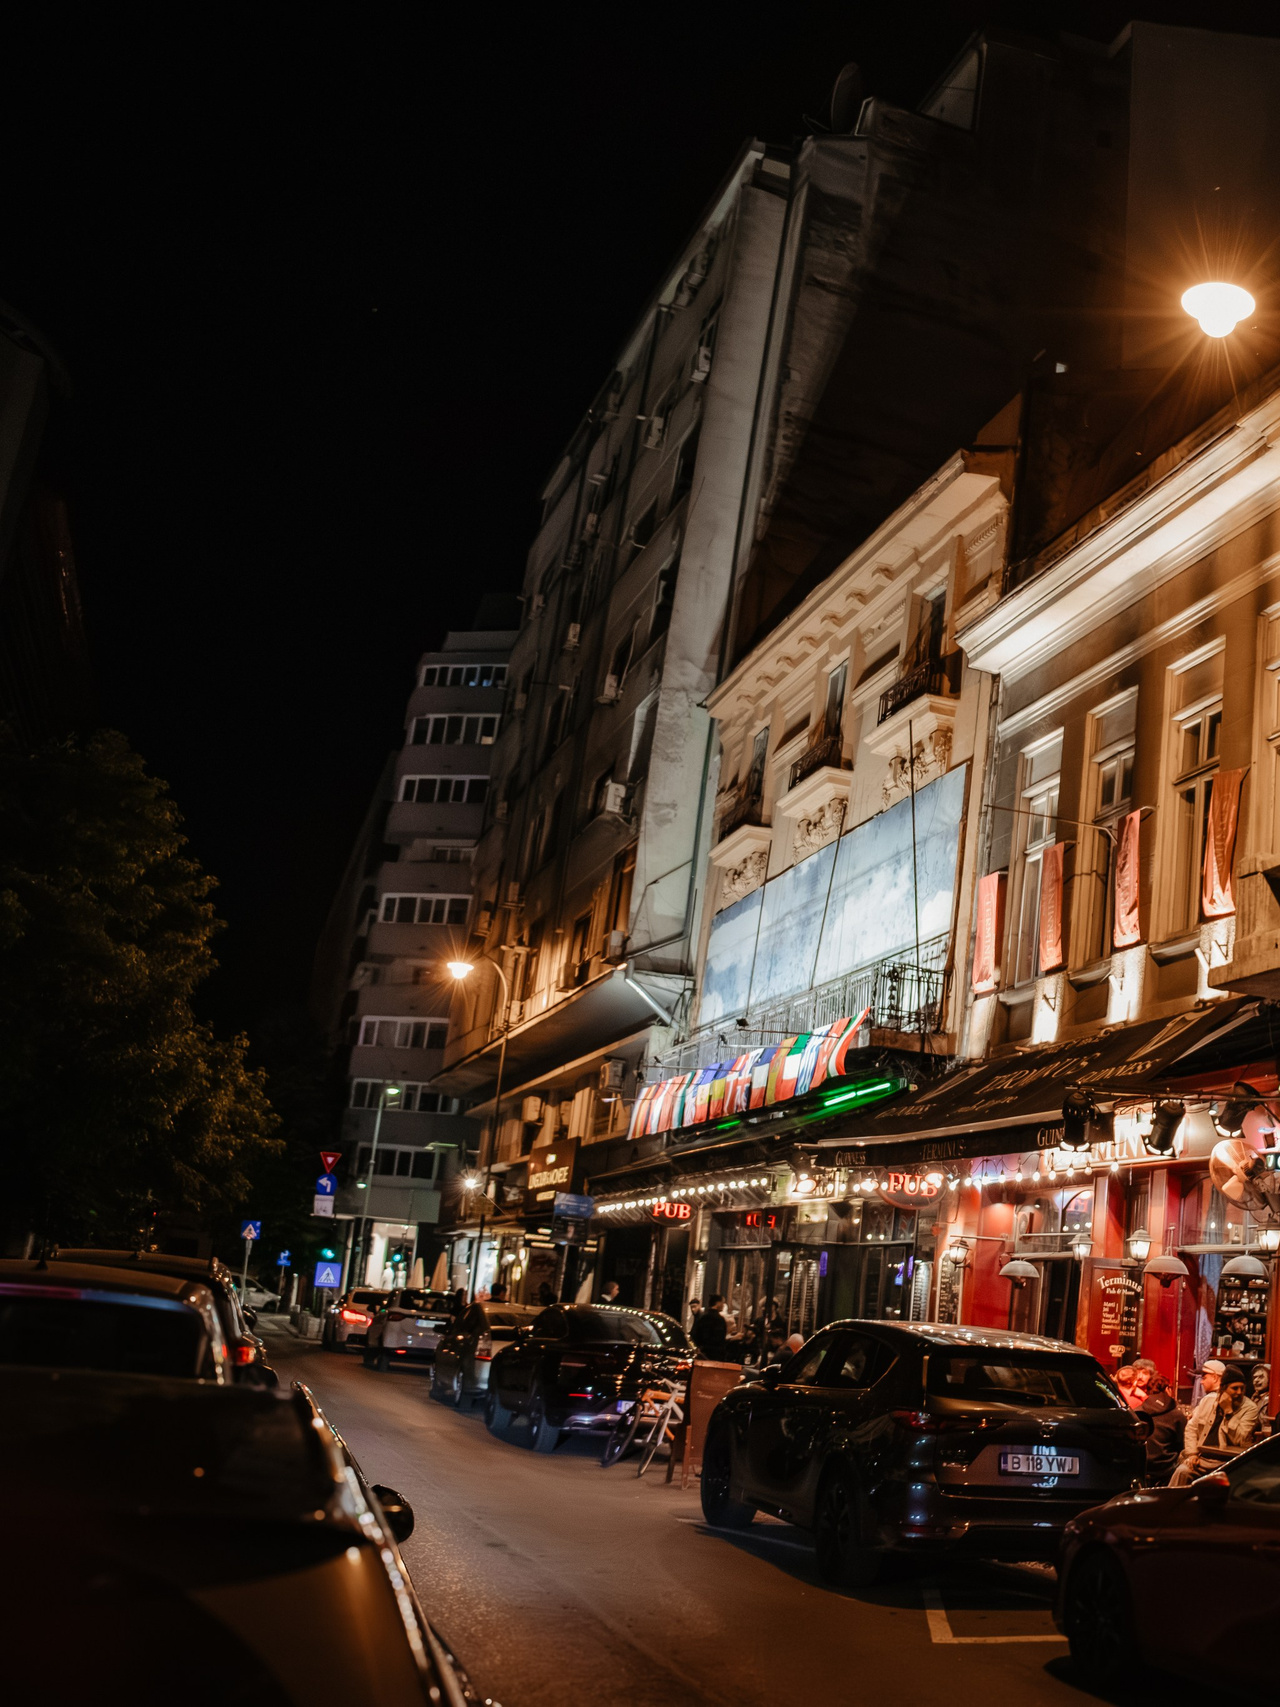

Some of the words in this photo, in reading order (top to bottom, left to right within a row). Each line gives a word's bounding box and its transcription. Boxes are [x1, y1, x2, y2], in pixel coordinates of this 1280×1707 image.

[888, 1172, 944, 1197] PUB
[653, 1202, 691, 1219] PUB
[1097, 1275, 1142, 1292] Terminus
[1012, 1457, 1021, 1469] B
[1027, 1457, 1042, 1470] 118
[1046, 1457, 1074, 1472] YWJ
